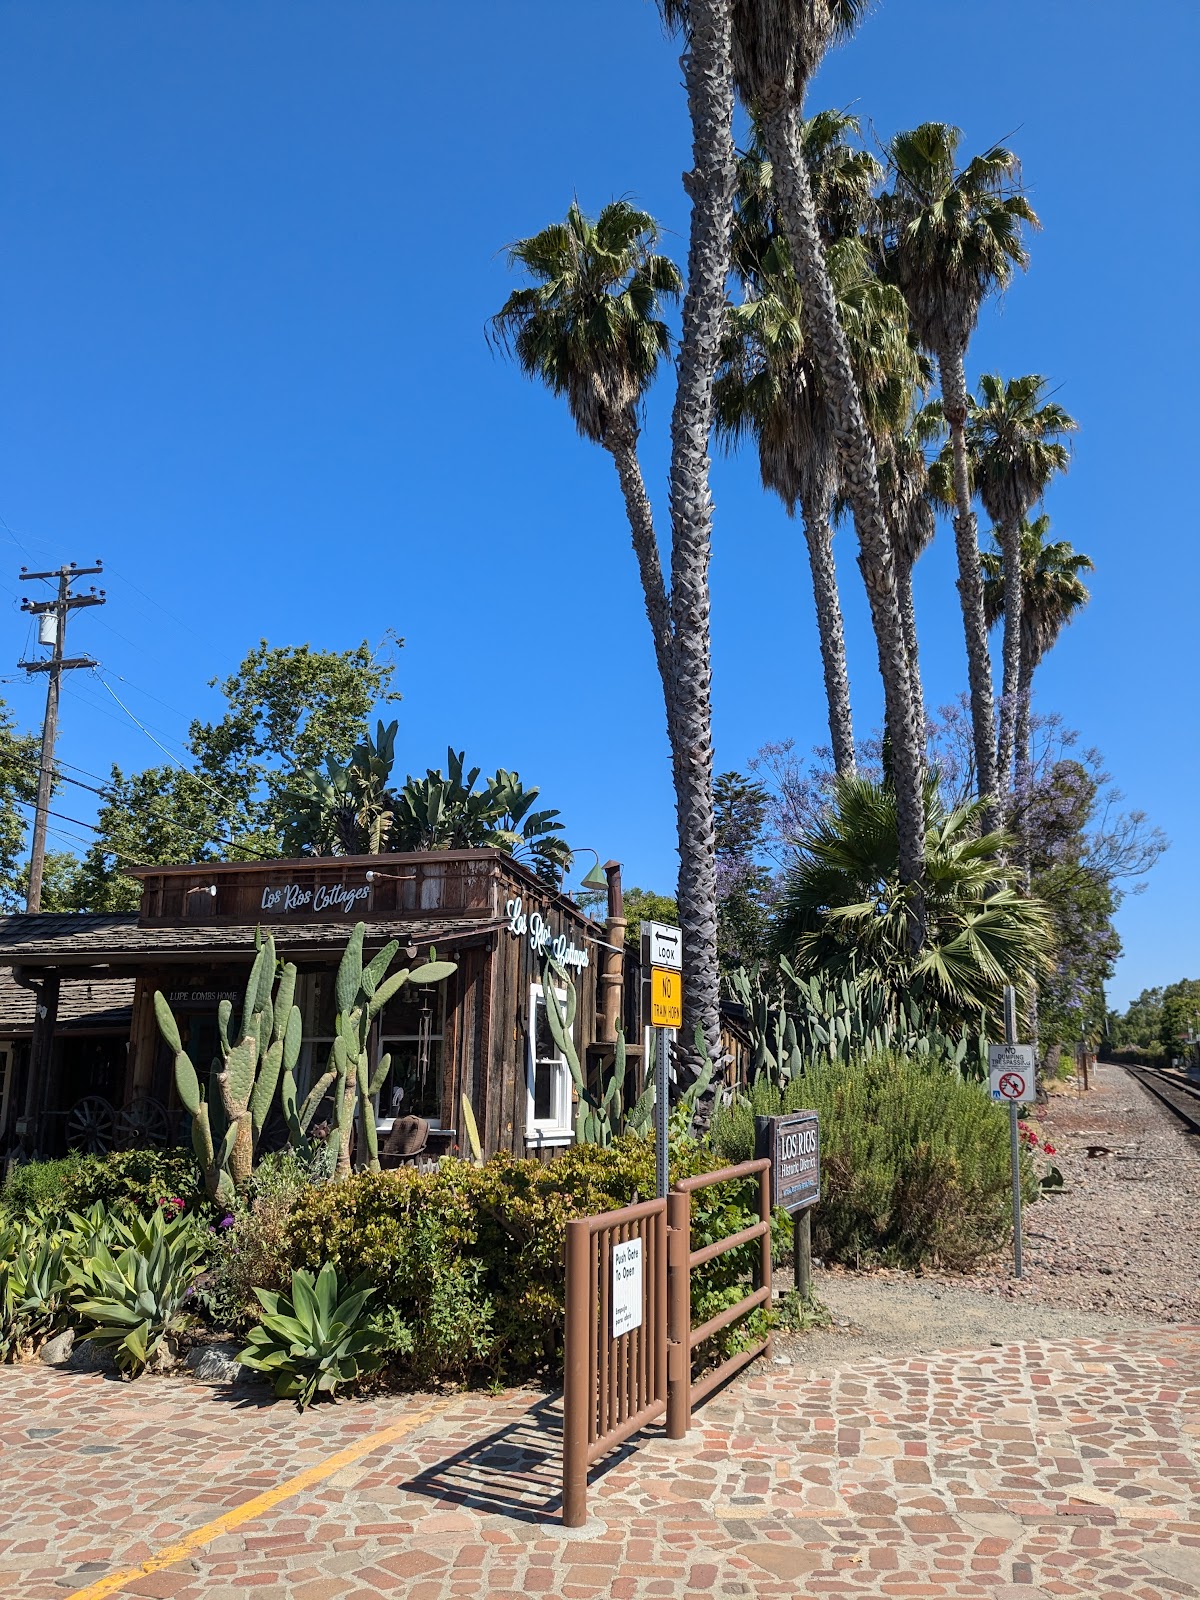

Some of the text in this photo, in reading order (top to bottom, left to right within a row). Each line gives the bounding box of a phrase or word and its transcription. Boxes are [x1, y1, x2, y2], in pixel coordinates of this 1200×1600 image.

[261, 883, 371, 913] Los Rios Cottages
[506, 896, 528, 935] Los
[553, 934, 589, 975] Cottages
[658, 946, 675, 960] LOOK
[169, 991, 238, 1001] LUPE COMBS HOME
[662, 978, 672, 999] NO
[653, 1003, 680, 1019] TRAIN HORN
[1005, 1046, 1016, 1055] NO
[991, 1058, 1031, 1066] TRESPASSING
[781, 1130, 816, 1160] LOS RIOS
[781, 1157, 816, 1178] Historic District
[615, 1248, 639, 1266] Push Gate
[615, 1266, 635, 1281] To Open
